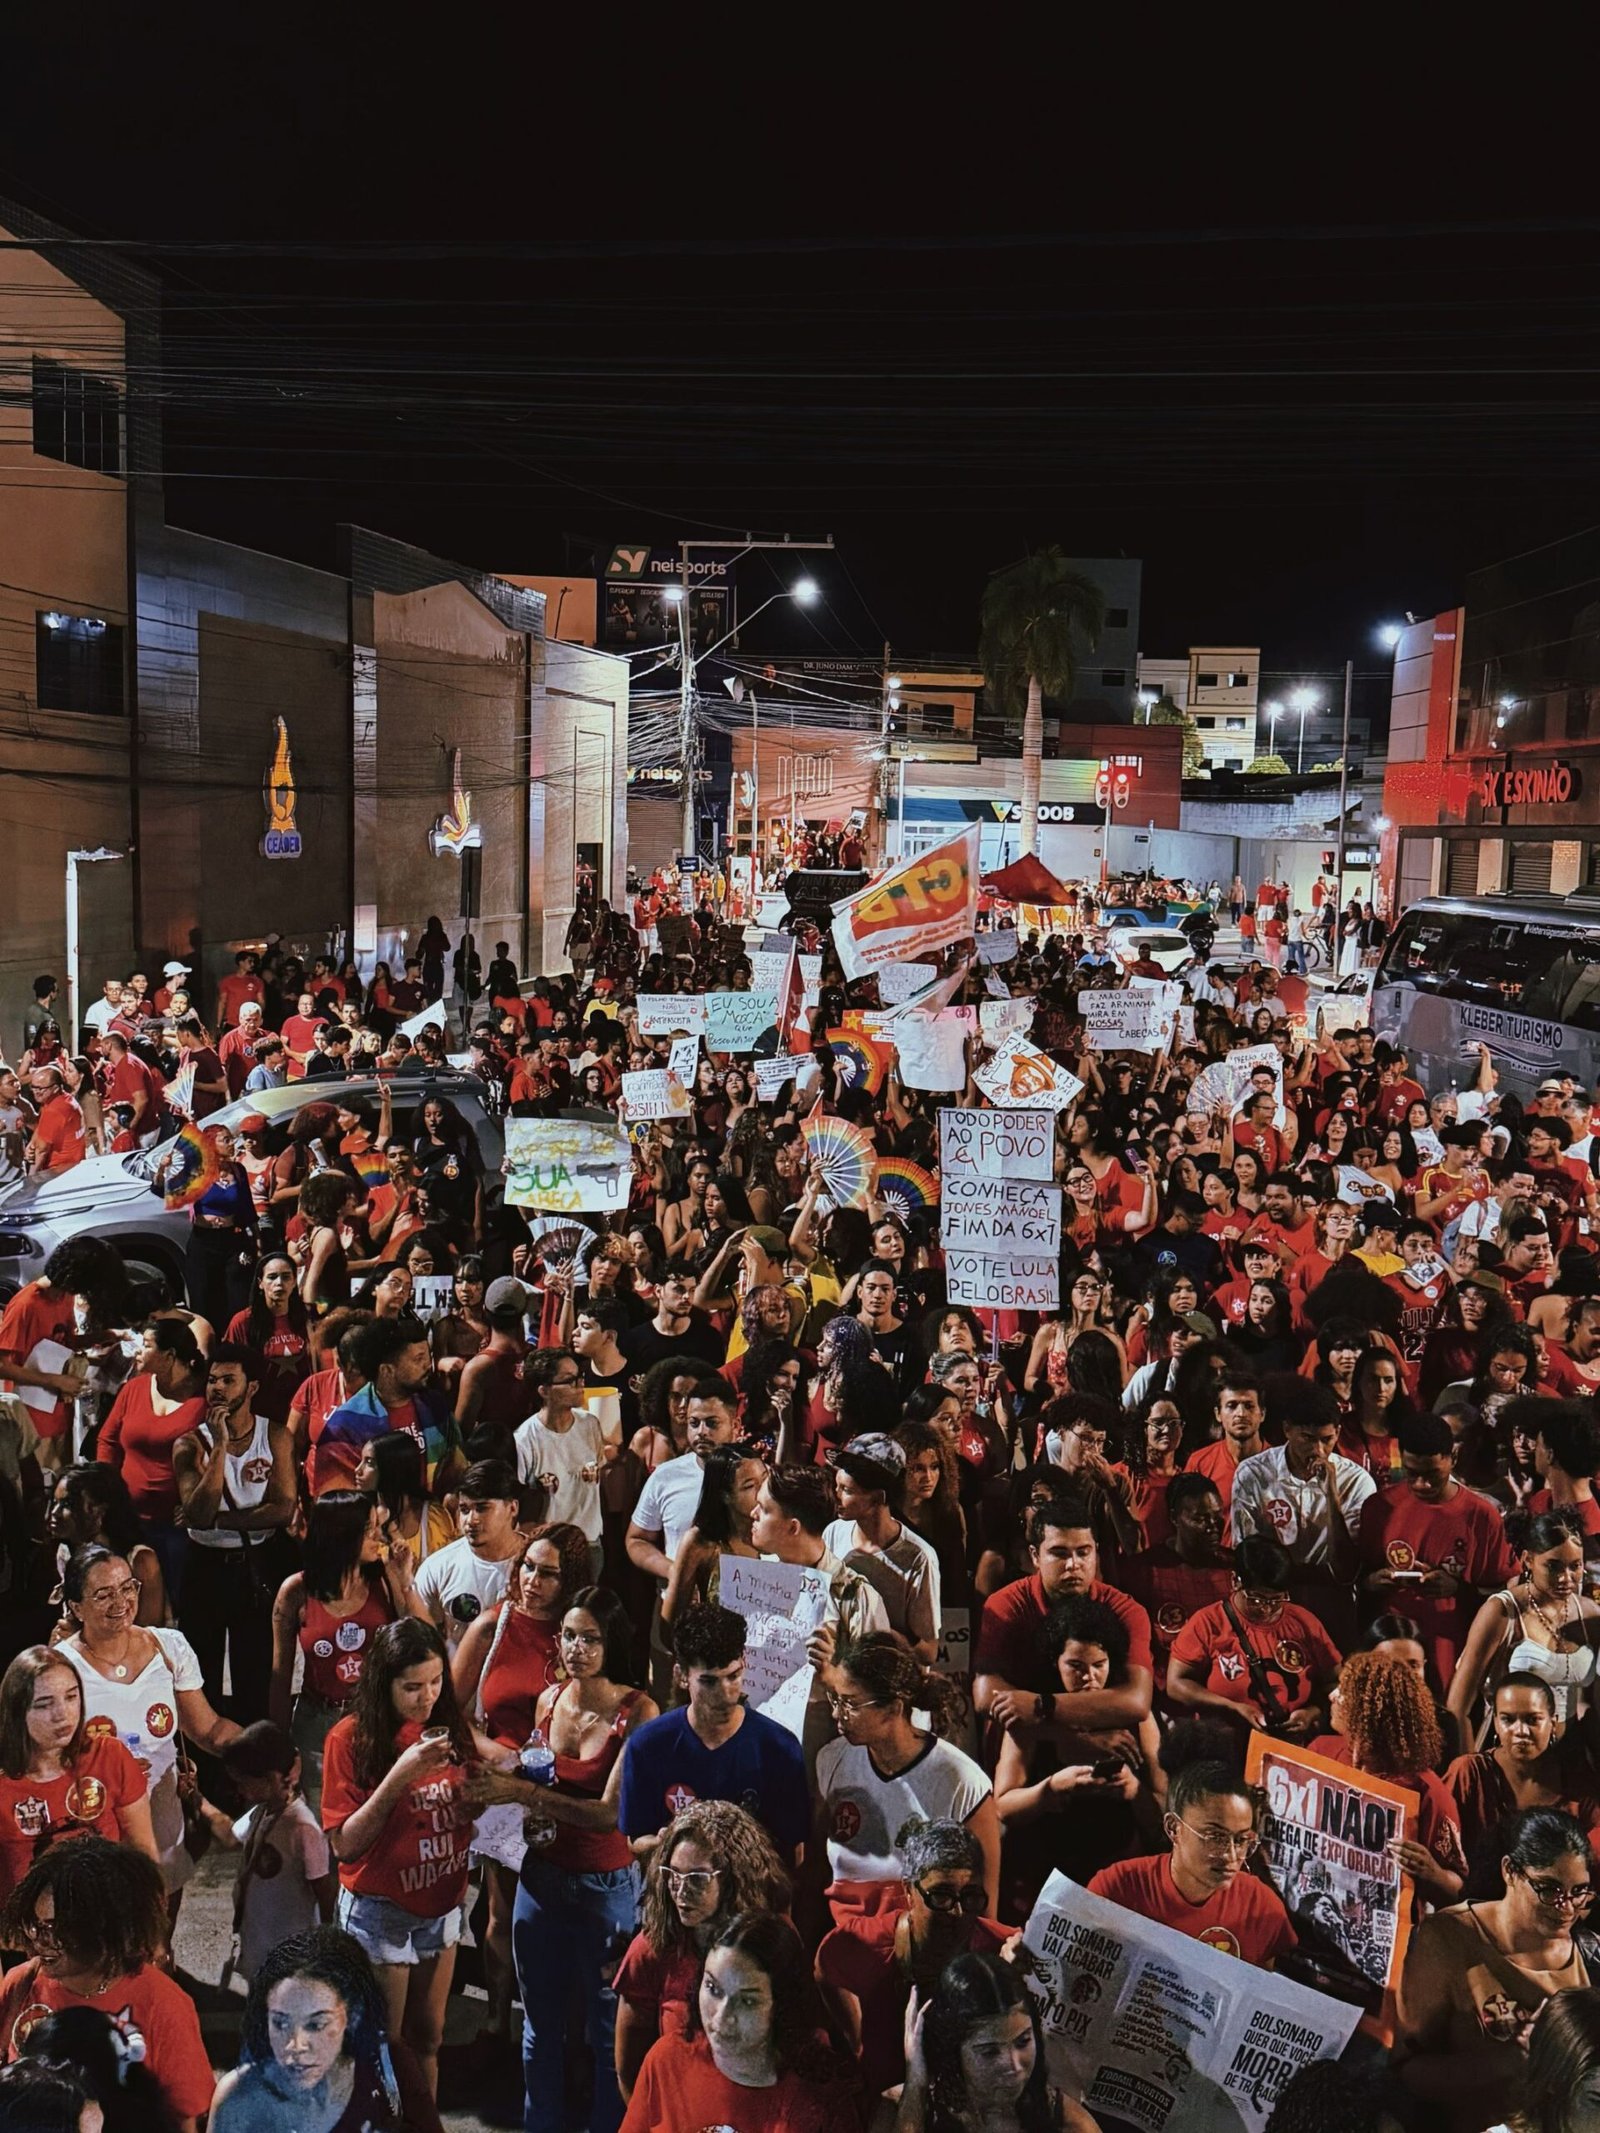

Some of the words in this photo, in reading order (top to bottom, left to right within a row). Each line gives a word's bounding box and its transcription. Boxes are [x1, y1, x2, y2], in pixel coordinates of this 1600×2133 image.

[640, 765, 714, 784] neisprts
[1011, 804, 1075, 822] SOOB
[711, 996, 733, 1012] EU
[738, 996, 767, 1010] SOU
[1090, 1002, 1107, 1010] FAZ
[1127, 991, 1145, 1000] QUE
[1086, 1019, 1124, 1028] NOSSAS
[1460, 1005, 1504, 1036] KLEBER
[1506, 1015, 1563, 1049] TURISMO
[1003, 1036, 1029, 1055] FAZ
[943, 1110, 991, 1128] TODO
[993, 1113, 1047, 1134] PODER
[947, 1126, 973, 1145] AO
[980, 1131, 1046, 1161] POVO
[512, 1162, 574, 1193] SUA
[947, 1180, 1050, 1206] CONHEÇA
[944, 1202, 992, 1216] JONES
[993, 1203, 1058, 1222] MANOEL
[992, 1219, 1016, 1238] DA
[1021, 1221, 1056, 1246] 6x1
[948, 1254, 1007, 1280] VOTE
[1010, 1261, 1057, 1279] LULA
[948, 1278, 1000, 1302] PELO
[1274, 1508, 1285, 1518] 13
[1390, 1548, 1410, 1565] 13
[732, 1569, 742, 1583] A
[1280, 1646, 1301, 1667] 13
[345, 1662, 357, 1674] 13
[27, 1803, 37, 1814] 13
[675, 1796, 687, 1809] 13
[1267, 1765, 1319, 1829] 6x1
[1320, 1787, 1398, 1853] NÃO!
[419, 1832, 454, 1861] RUI
[1304, 1830, 1319, 1856] DE
[1320, 1838, 1396, 1882] EXPLORAÇÃO
[1046, 1913, 1124, 1963] BOLSONARO
[1041, 1933, 1062, 1958] VAI
[1063, 1943, 1115, 1981] ACABAR
[1140, 1969, 1199, 2000] BOLSONARO
[1164, 1989, 1213, 2022] CONGELAR
[1497, 2001, 1509, 2016] 13
[1052, 2002, 1064, 2025] O
[1066, 2008, 1095, 2037] PIX
[1250, 2009, 1324, 2052] BOLSONARO
[1115, 2029, 1131, 2040] DO
[1165, 2030, 1174, 2039] O
[1243, 2028, 1271, 2050] QUER
[1269, 2037, 1290, 2058] QUE
[1230, 2043, 1294, 2088] MORR
[1223, 2071, 1240, 2089] DE
